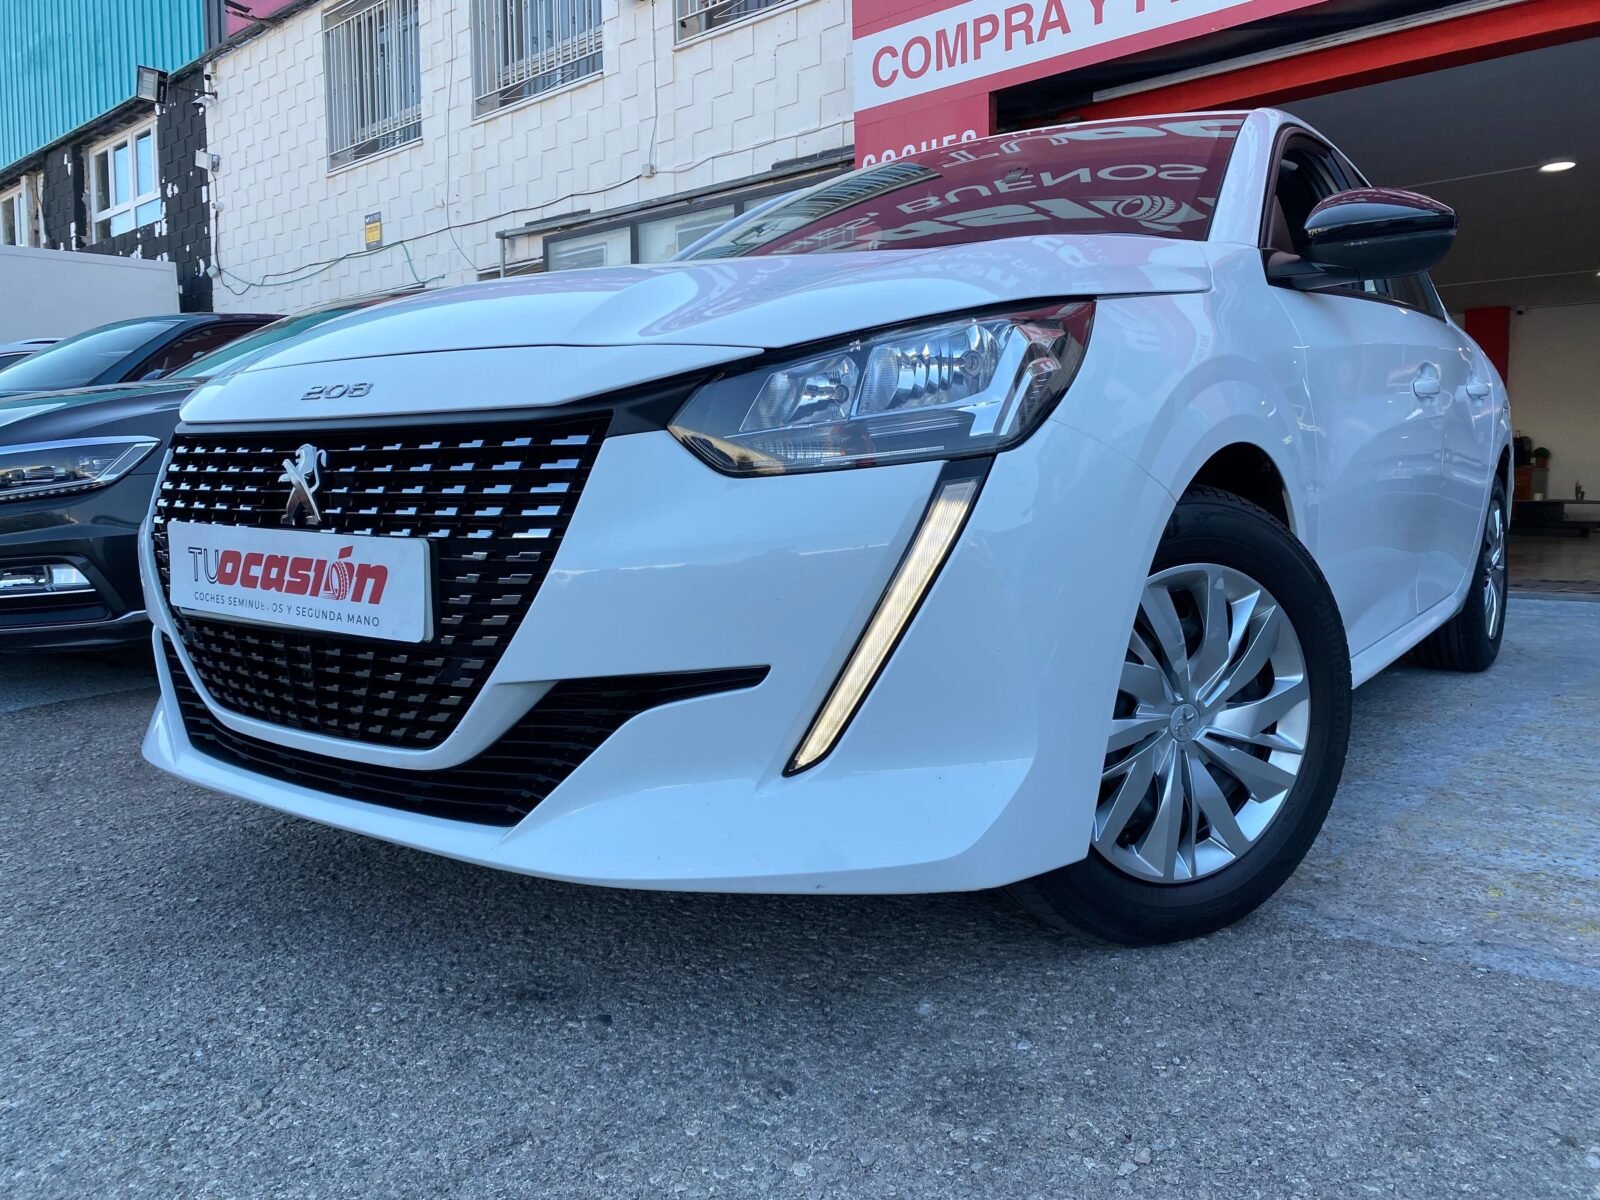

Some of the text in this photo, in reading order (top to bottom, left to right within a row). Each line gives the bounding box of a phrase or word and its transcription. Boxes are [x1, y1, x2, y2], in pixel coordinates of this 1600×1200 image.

[871, 0, 1072, 89] COMPRA
[300, 382, 374, 401] 208
[194, 591, 381, 628] COCHES SEMINUEOS Y SEGUNDA MANO
